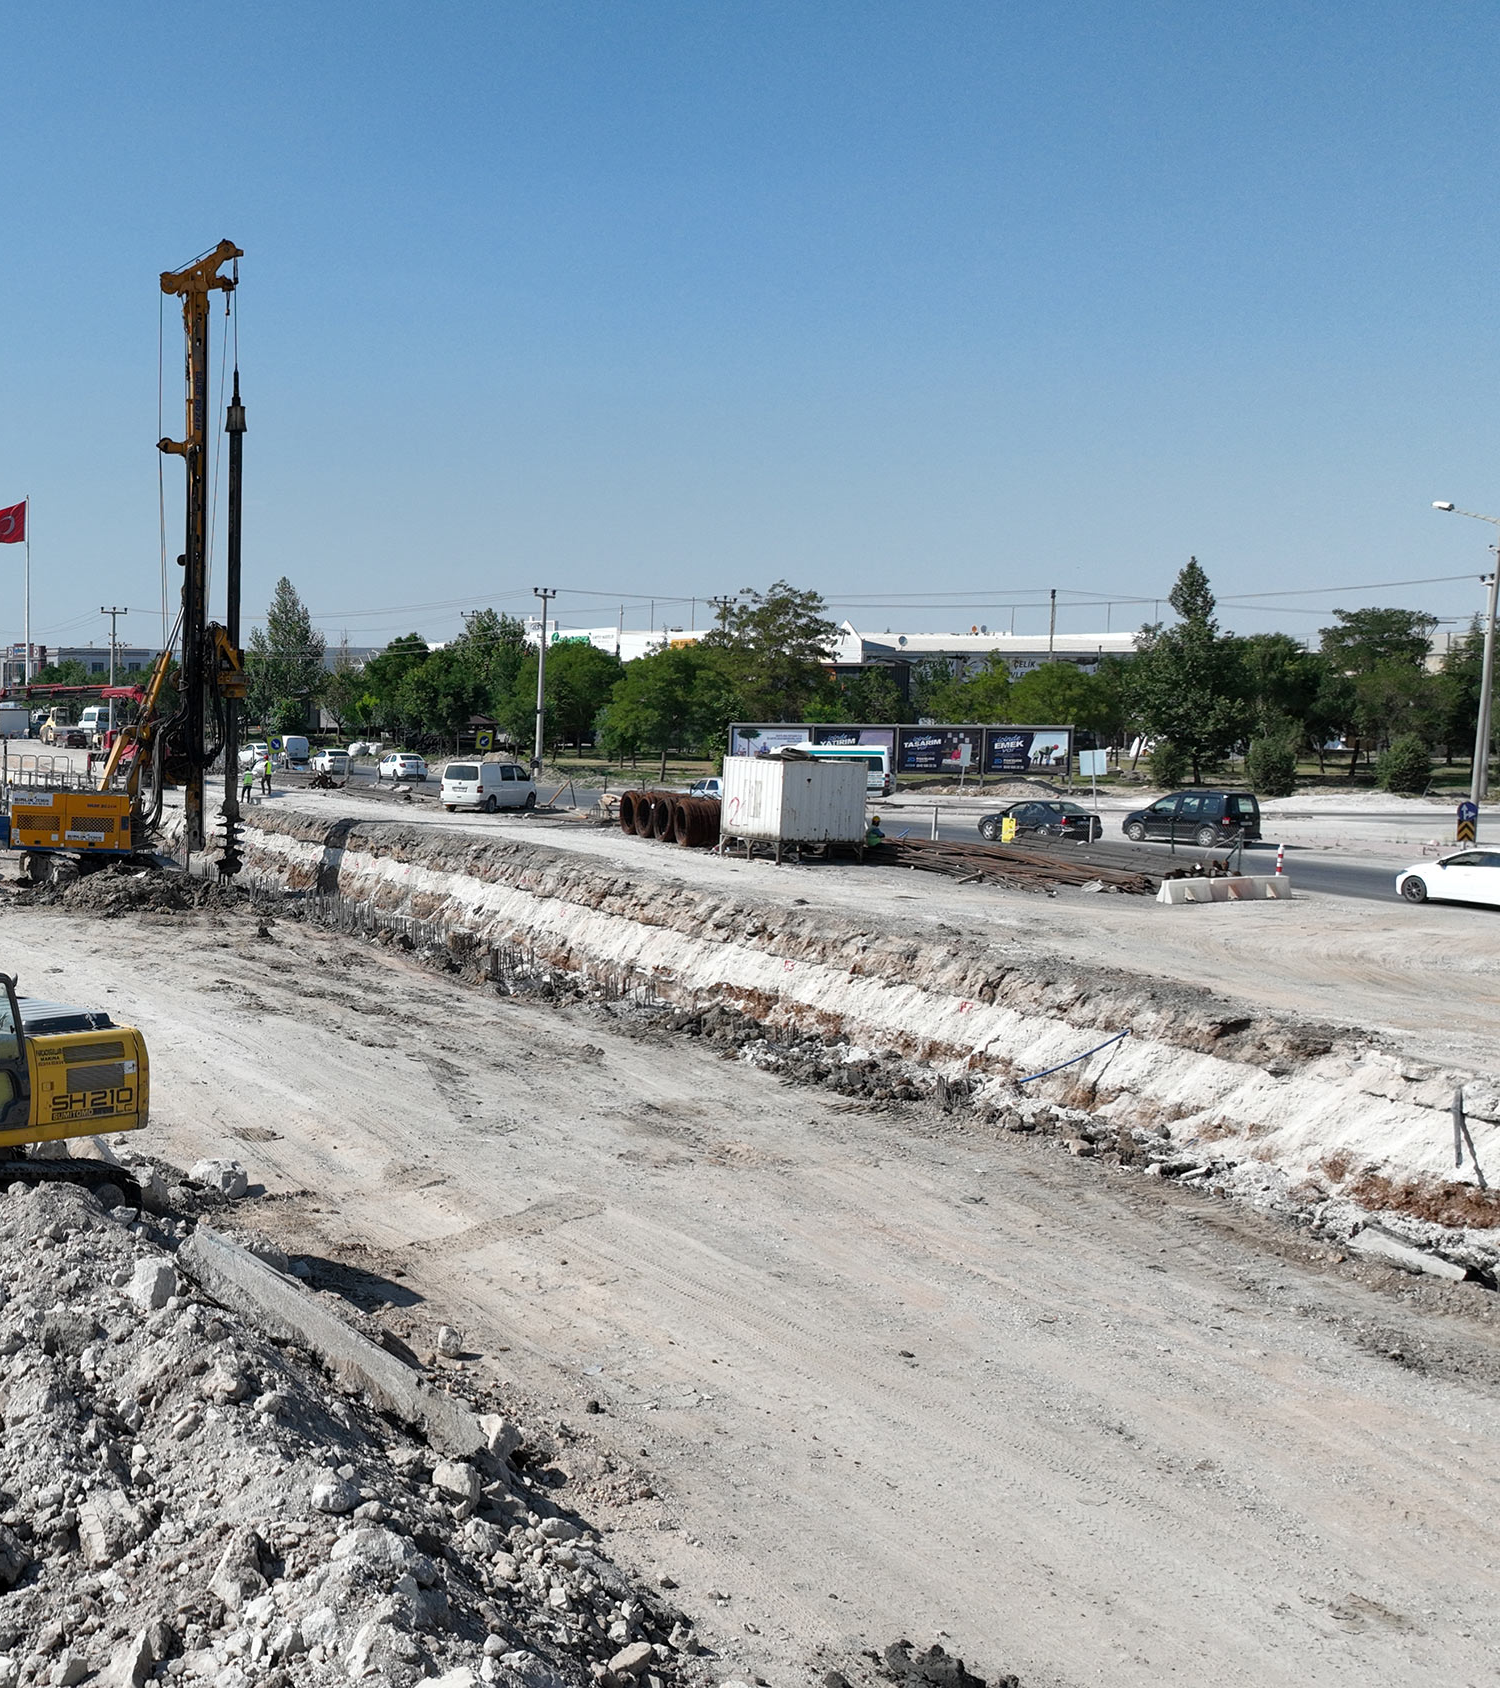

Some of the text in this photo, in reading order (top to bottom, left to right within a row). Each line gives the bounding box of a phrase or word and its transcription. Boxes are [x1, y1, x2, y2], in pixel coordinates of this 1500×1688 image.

[903, 738, 942, 748] TASARIM
[994, 740, 1024, 750] EMEK
[53, 1109, 94, 1120] SUMITOMO
